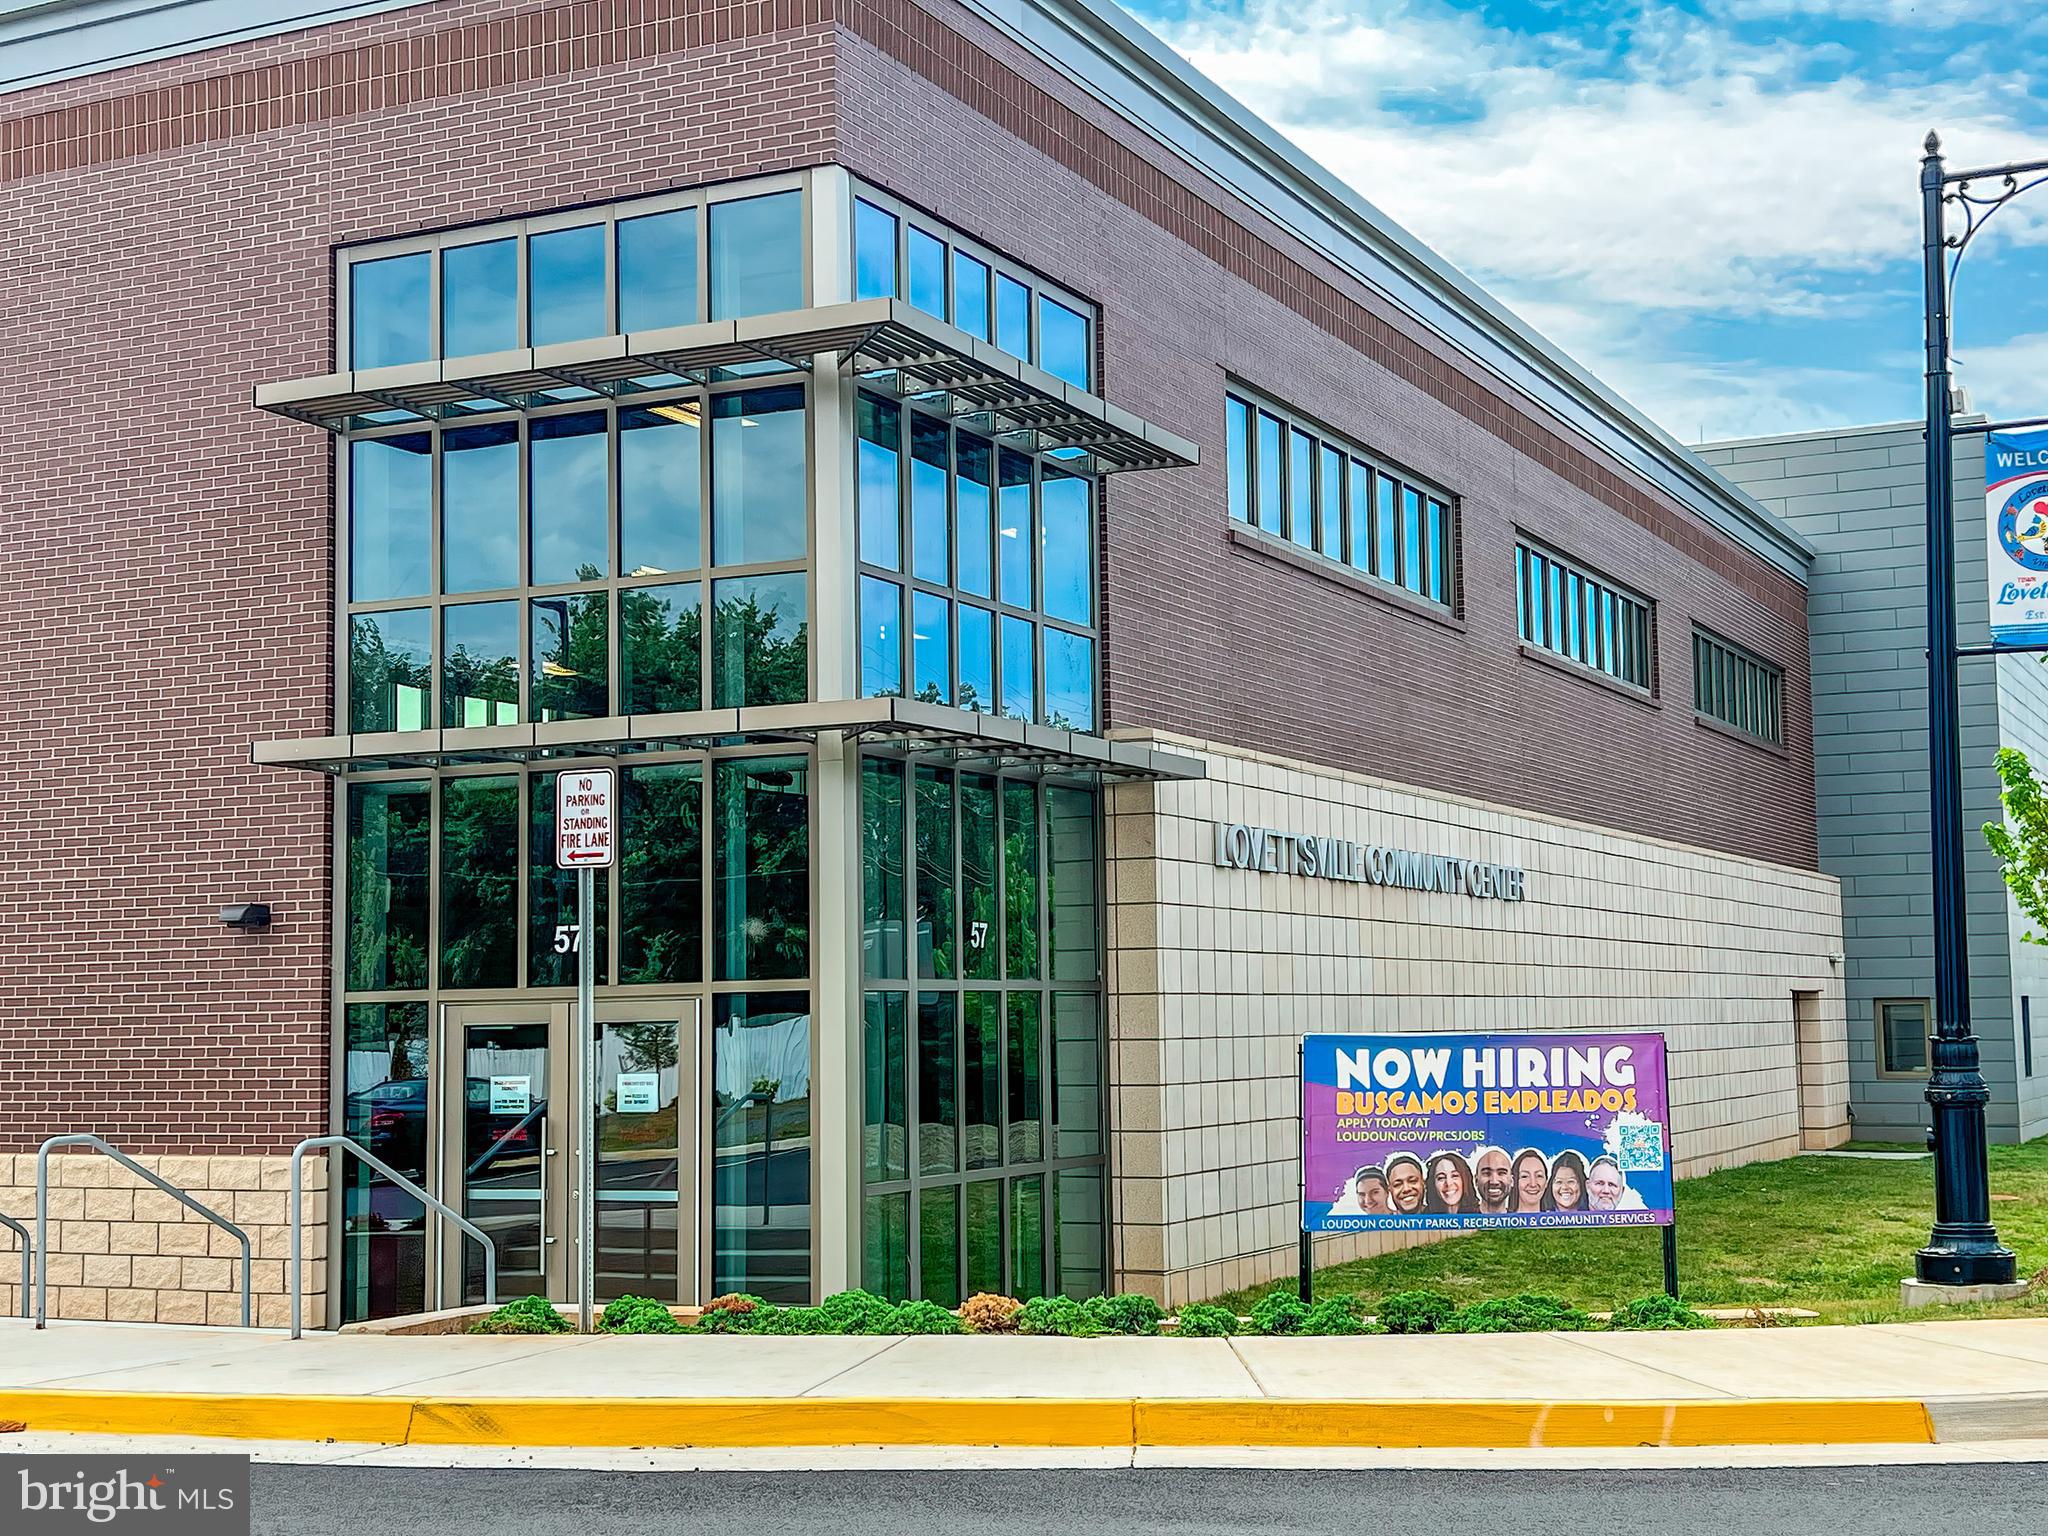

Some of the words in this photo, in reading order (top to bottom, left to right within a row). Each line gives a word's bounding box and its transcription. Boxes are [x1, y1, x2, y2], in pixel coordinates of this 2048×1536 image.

[578, 778, 593, 792] NO
[565, 793, 606, 808] PARKING
[563, 816, 608, 831] STANDING
[561, 833, 582, 849] FIRE
[584, 831, 610, 847] LANE
[1214, 822, 1366, 884] LOVETTSVILLE
[1364, 844, 1467, 896] COMMUNITY
[1466, 860, 1527, 902] CENTER
[970, 921, 988, 949] 57
[1335, 1047, 1452, 1090] NOW
[1462, 1045, 1636, 1089] HIRING
[1335, 1090, 1478, 1116] BUSCAMOS
[1483, 1088, 1637, 1114] EMPLEADOS
[1336, 1118, 1375, 1129] APPLY
[1374, 1117, 1415, 1129] TODAY
[1414, 1117, 1431, 1128] AT
[1336, 1130, 1486, 1143] LOUDOUN.GOV/PRCSJOBS
[1321, 1218, 1377, 1230] LOUDOUN
[1377, 1217, 1423, 1229] COUNTY
[1425, 1217, 1462, 1229] PARKS,
[1462, 1215, 1527, 1229] RECREATION
[1529, 1215, 1537, 1227] &
[1540, 1213, 1607, 1227] COMMUNITY
[1608, 1212, 1656, 1225] SERVICES
